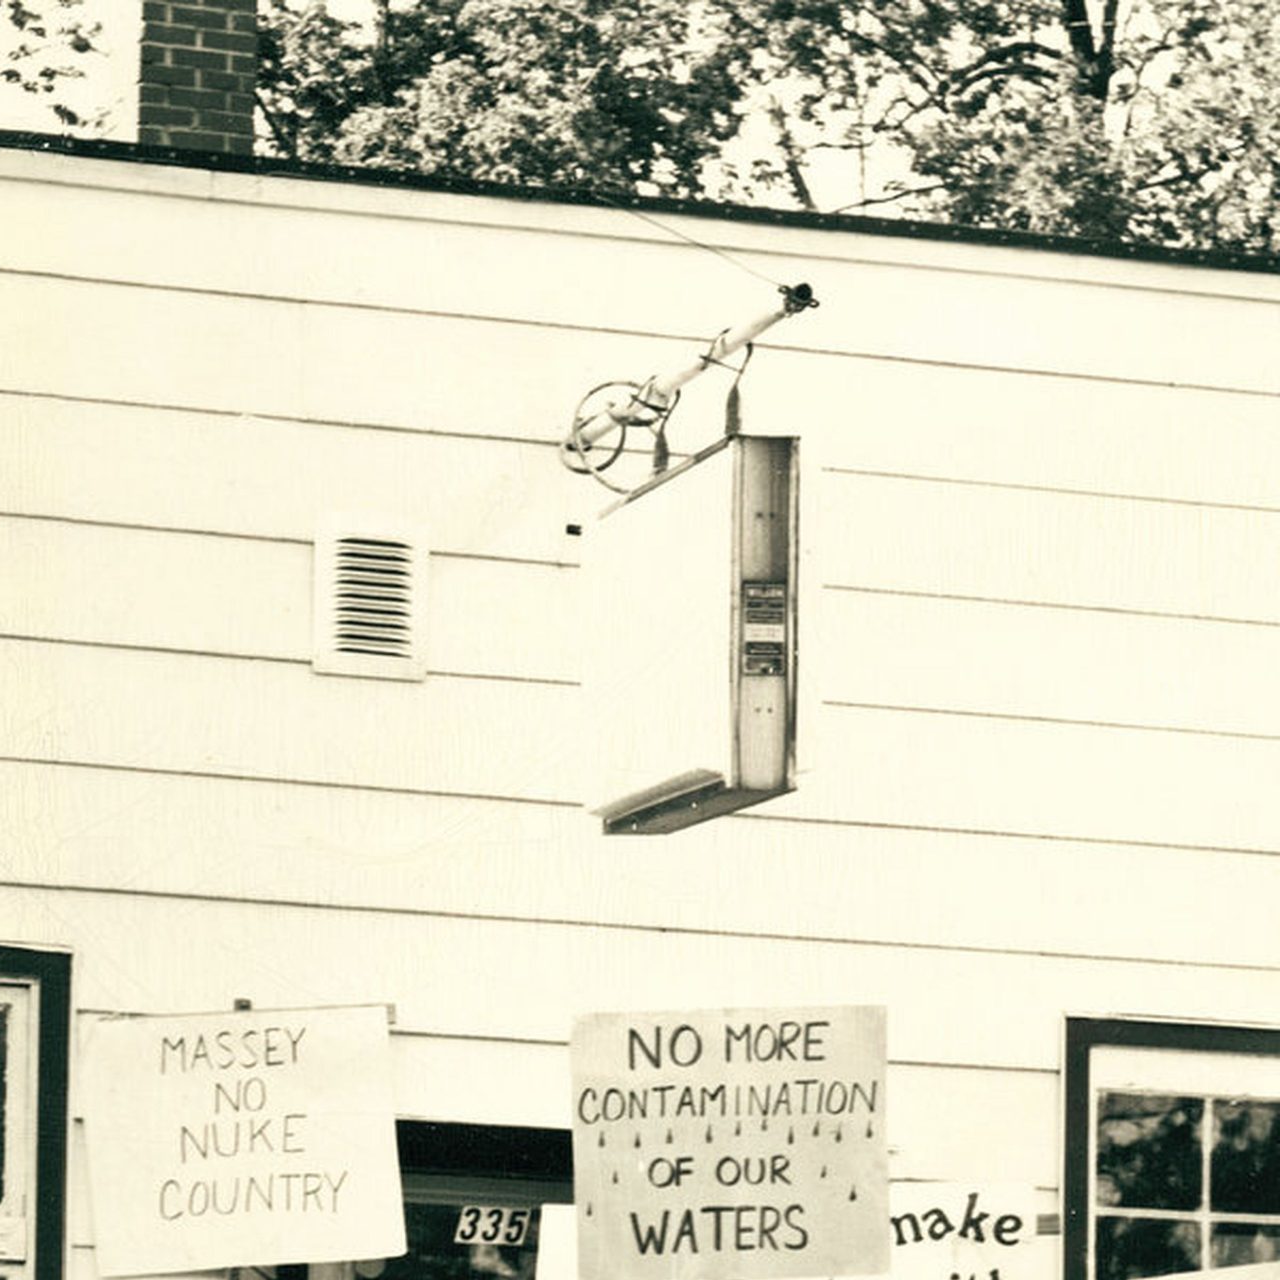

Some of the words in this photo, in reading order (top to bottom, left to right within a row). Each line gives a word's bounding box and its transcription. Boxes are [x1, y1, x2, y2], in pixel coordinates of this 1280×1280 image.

[160, 1027, 306, 1075] MASSEY
[628, 1024, 702, 1070] NO
[725, 1021, 830, 1063] MORE
[214, 1077, 266, 1114] NO
[578, 1080, 878, 1125] CONTAMINATION
[180, 1114, 308, 1164] NUKE
[159, 1170, 348, 1220] COUNTRY
[648, 1157, 694, 1189] OF
[715, 1155, 792, 1187] OUR
[459, 1207, 527, 1243] 335
[630, 1204, 809, 1255] WATERS
